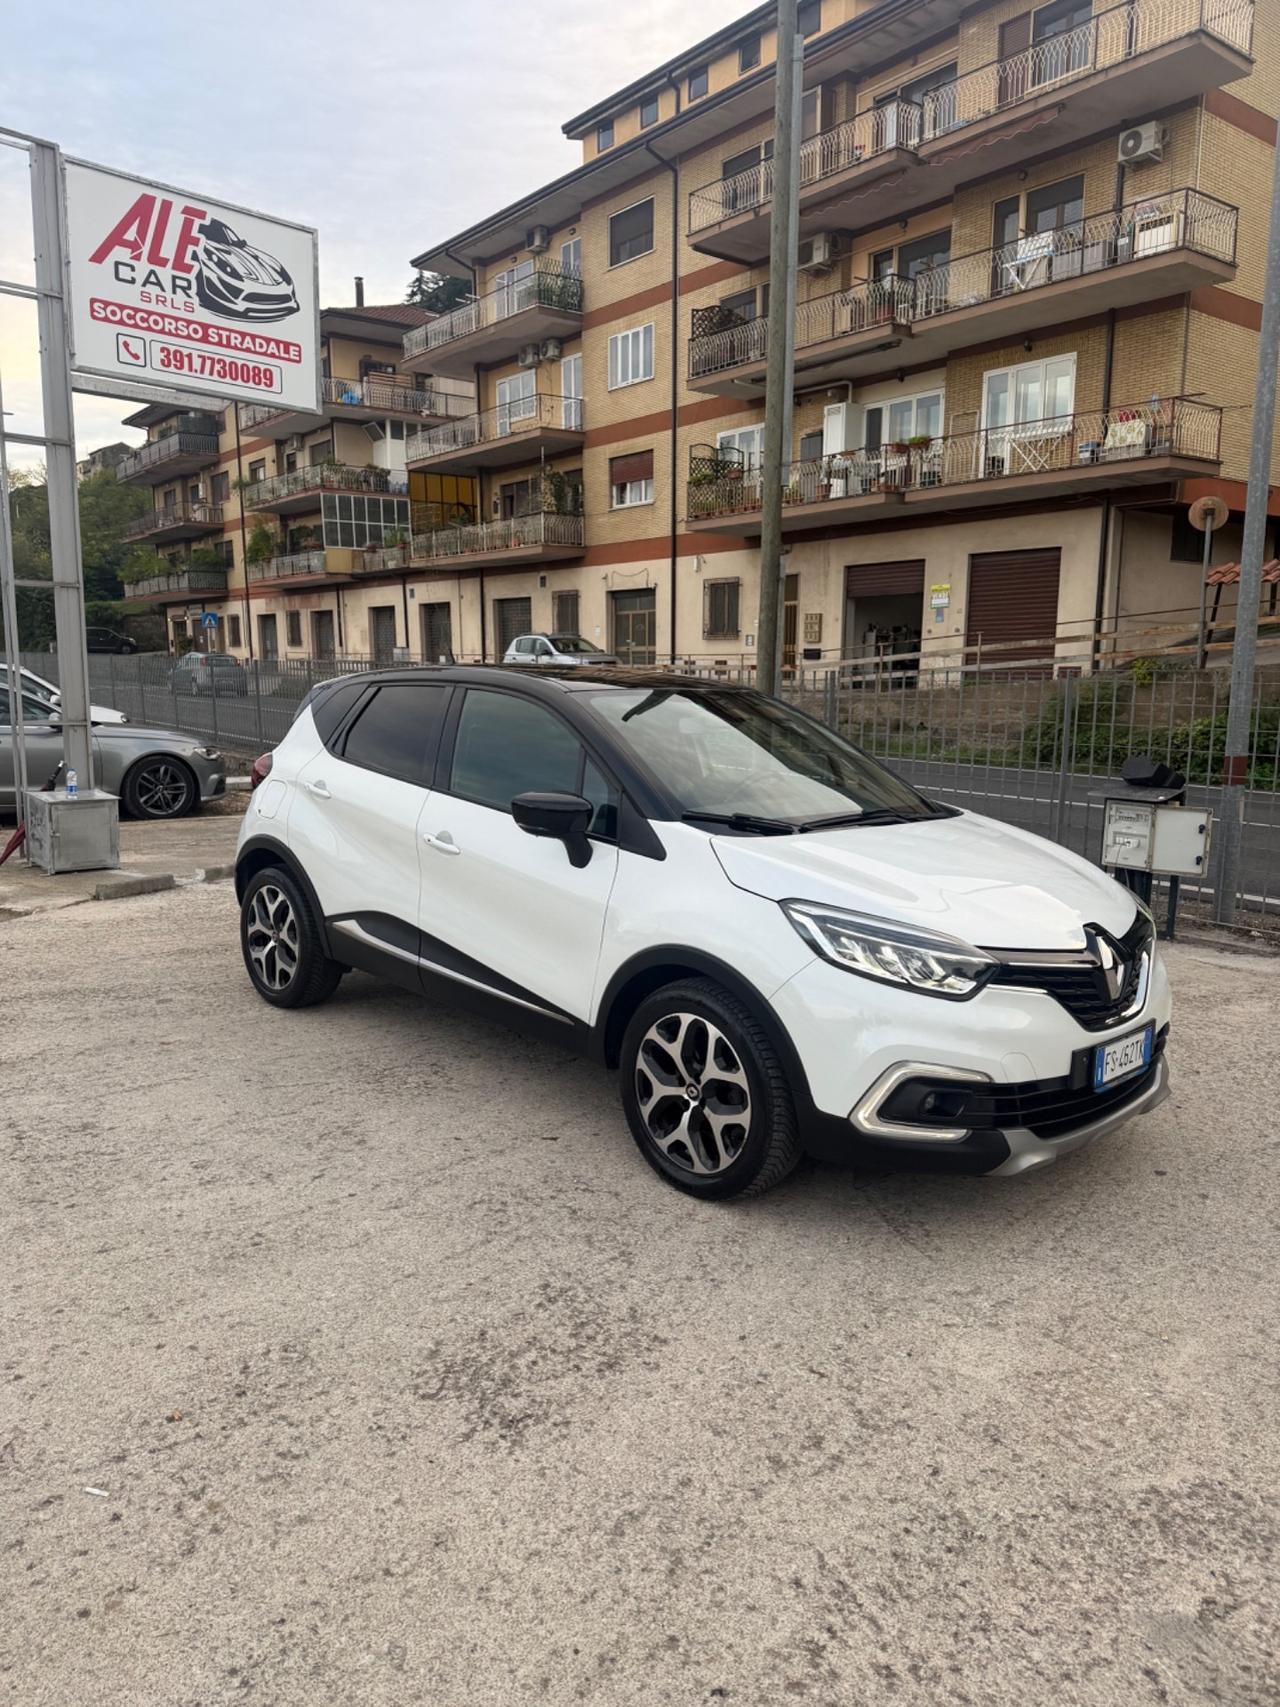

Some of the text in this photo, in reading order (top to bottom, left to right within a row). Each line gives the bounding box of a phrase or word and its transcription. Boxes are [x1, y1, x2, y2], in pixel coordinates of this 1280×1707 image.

[88, 193, 207, 274] ALE
[114, 260, 193, 299] CAR
[140, 290, 195, 313] SRLS
[93, 303, 300, 361] SOCCORSO STRADALE
[160, 346, 274, 389] 391.7730089
